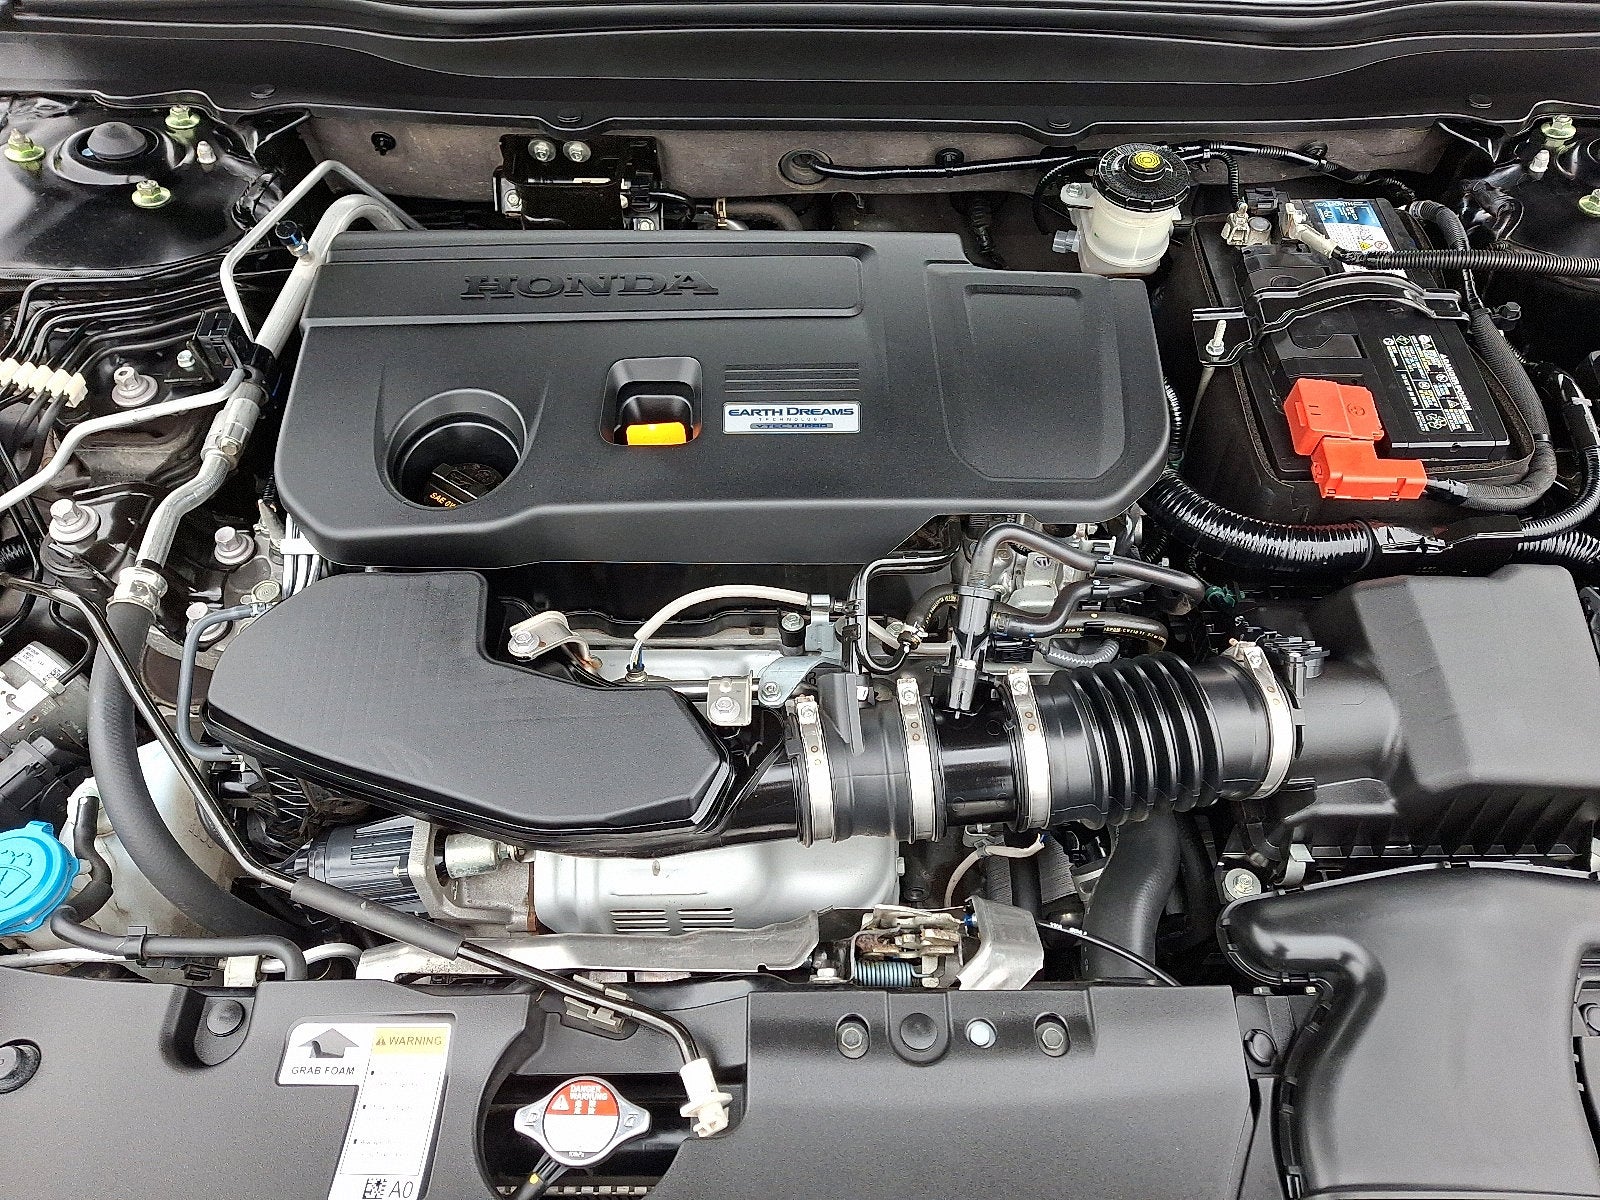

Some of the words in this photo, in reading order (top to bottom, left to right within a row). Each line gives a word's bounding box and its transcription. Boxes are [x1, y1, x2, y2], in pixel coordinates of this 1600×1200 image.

[460, 271, 719, 298] HONDA
[728, 408, 783, 417] EARTH
[786, 407, 854, 416] DREAMS
[429, 492, 447, 504] SAE
[389, 1036, 442, 1046] WARNING
[291, 1066, 321, 1075] GRAB
[324, 1066, 356, 1075] FOAM
